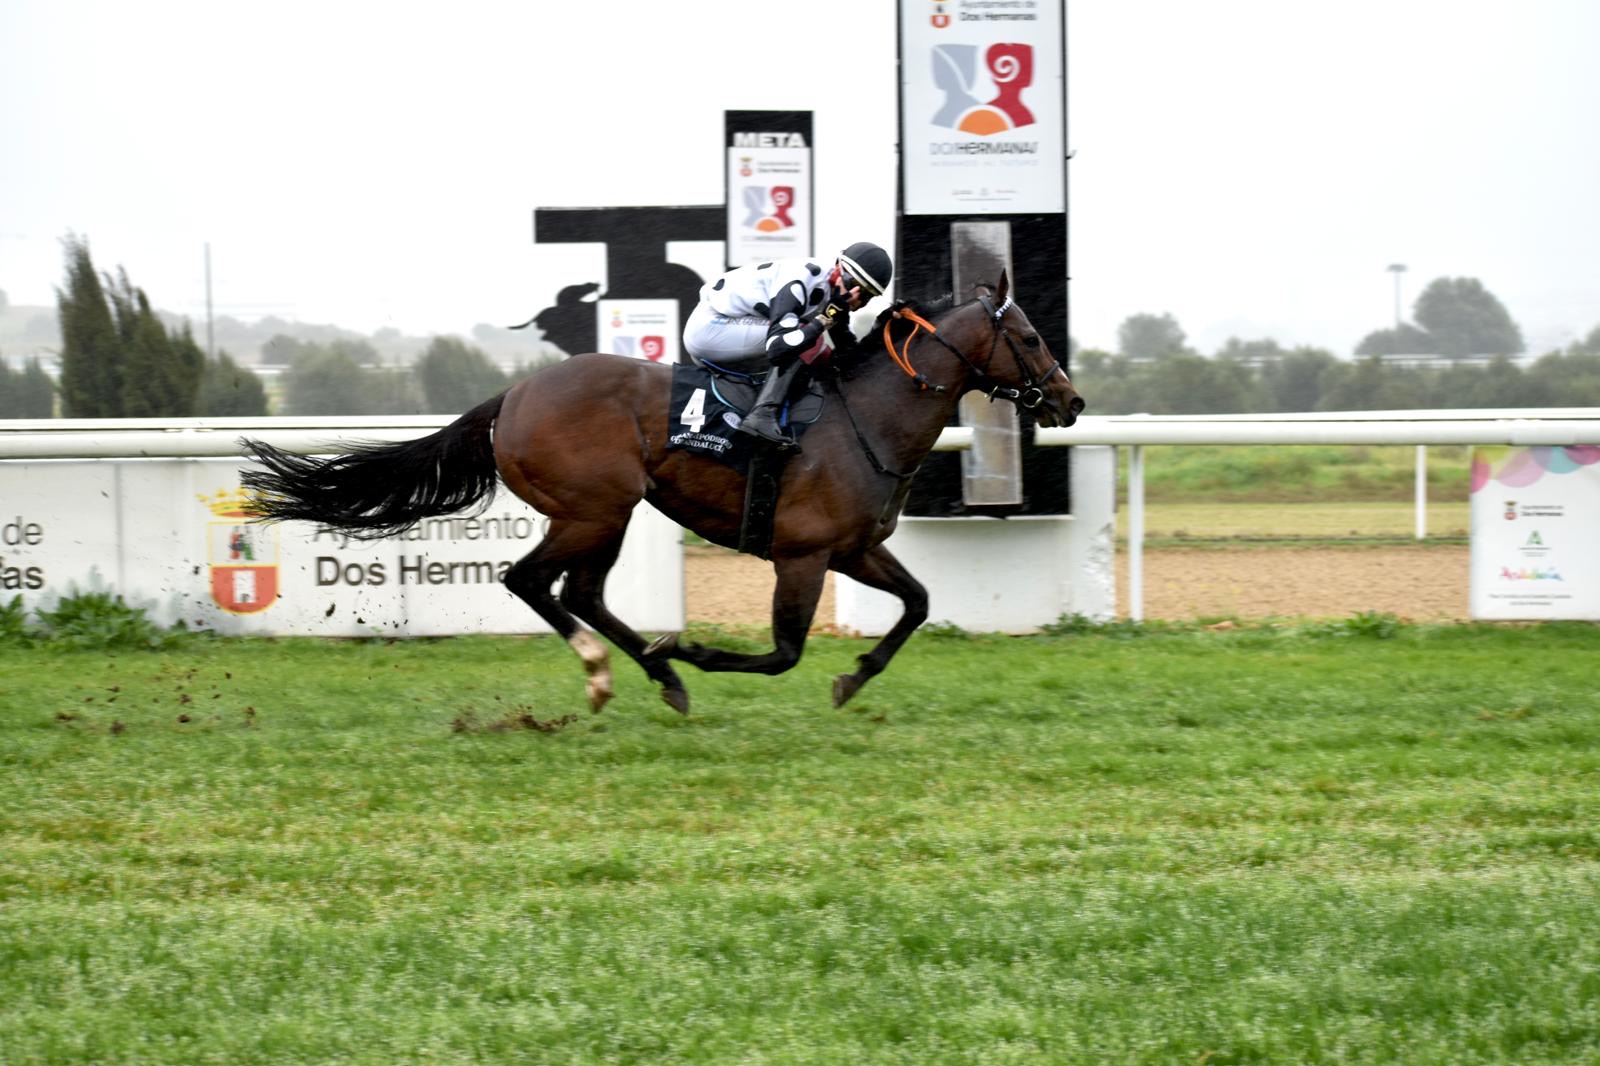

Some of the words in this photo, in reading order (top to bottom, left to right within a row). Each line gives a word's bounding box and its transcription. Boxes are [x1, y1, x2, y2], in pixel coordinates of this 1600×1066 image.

[733, 132, 807, 148] META
[680, 388, 706, 433] 4
[2, 515, 43, 546] de
[315, 555, 386, 587] Dos
[397, 554, 514, 586] Herma
